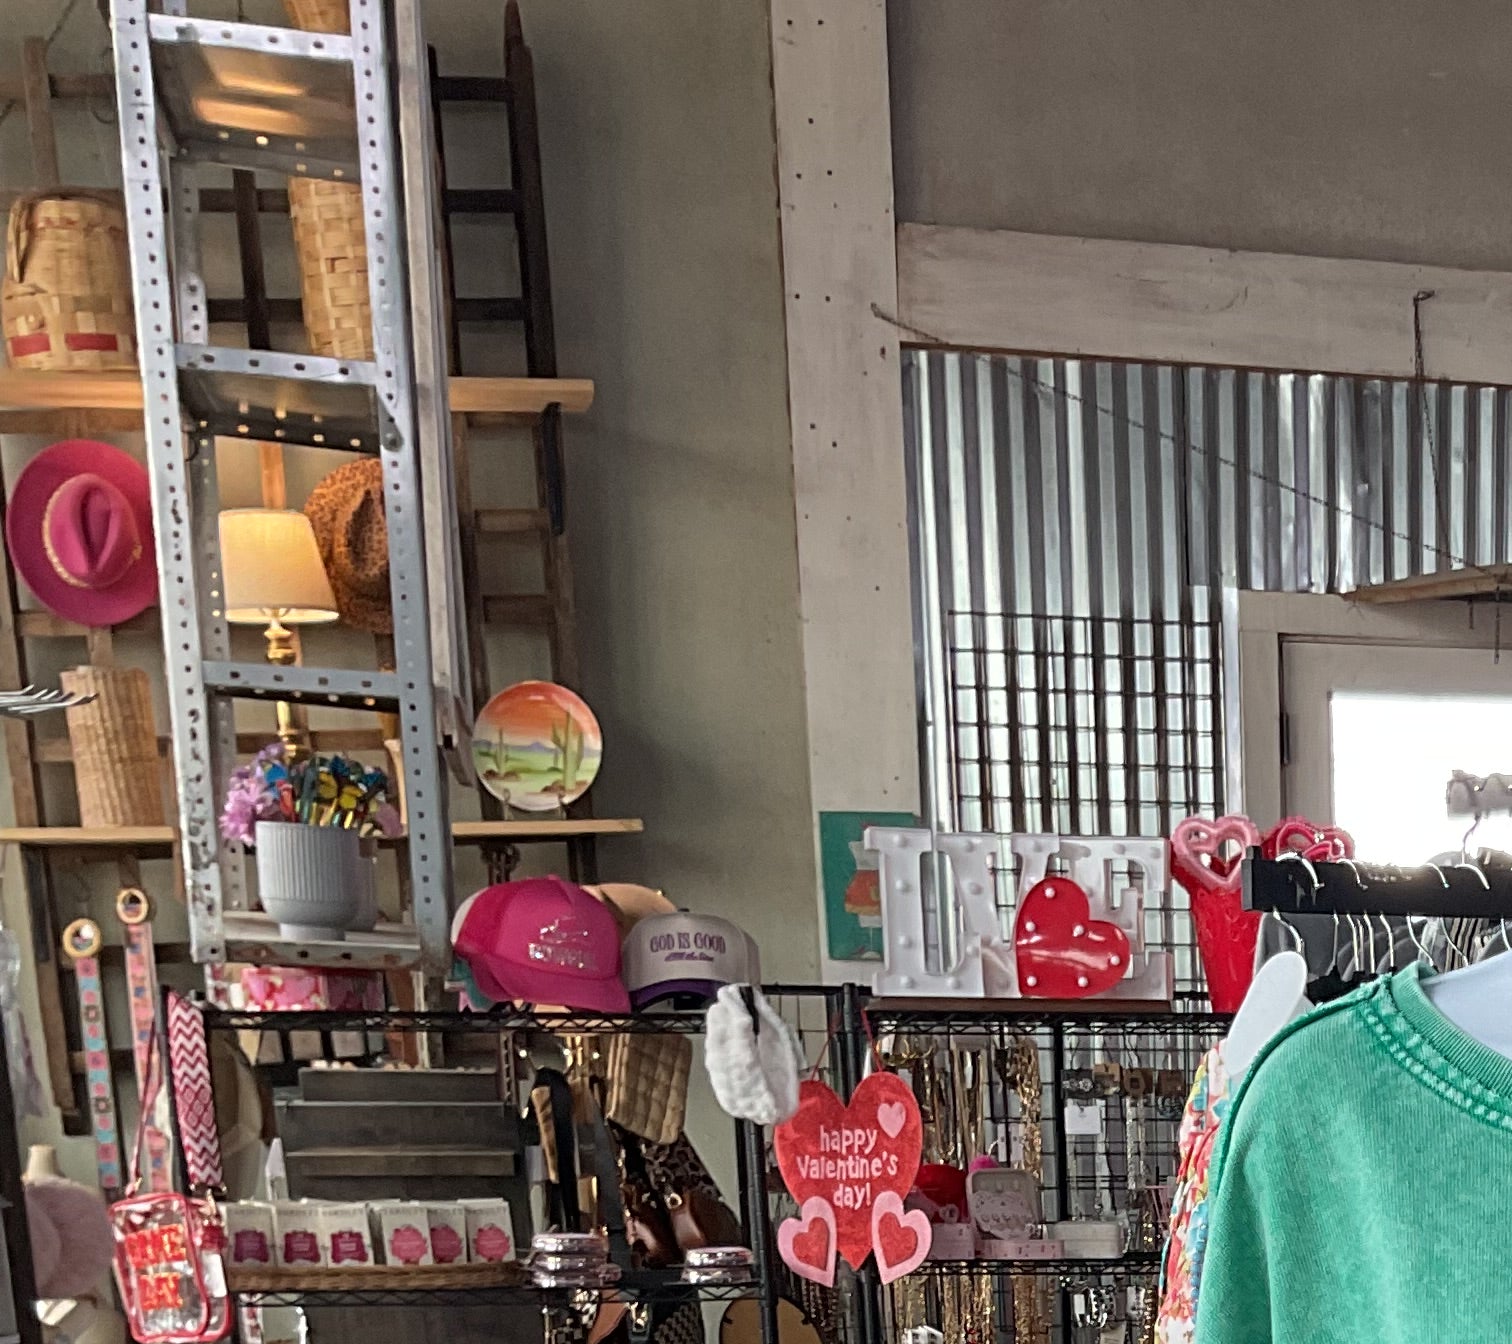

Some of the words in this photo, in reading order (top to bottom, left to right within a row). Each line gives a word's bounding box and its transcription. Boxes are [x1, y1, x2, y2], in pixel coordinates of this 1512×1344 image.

[650, 934, 675, 952] GOD
[678, 932, 690, 949] IS
[694, 932, 726, 954] GOOD
[820, 1125, 878, 1155] happy
[796, 1151, 898, 1180] Valentine's
[833, 1182, 871, 1210] day!
